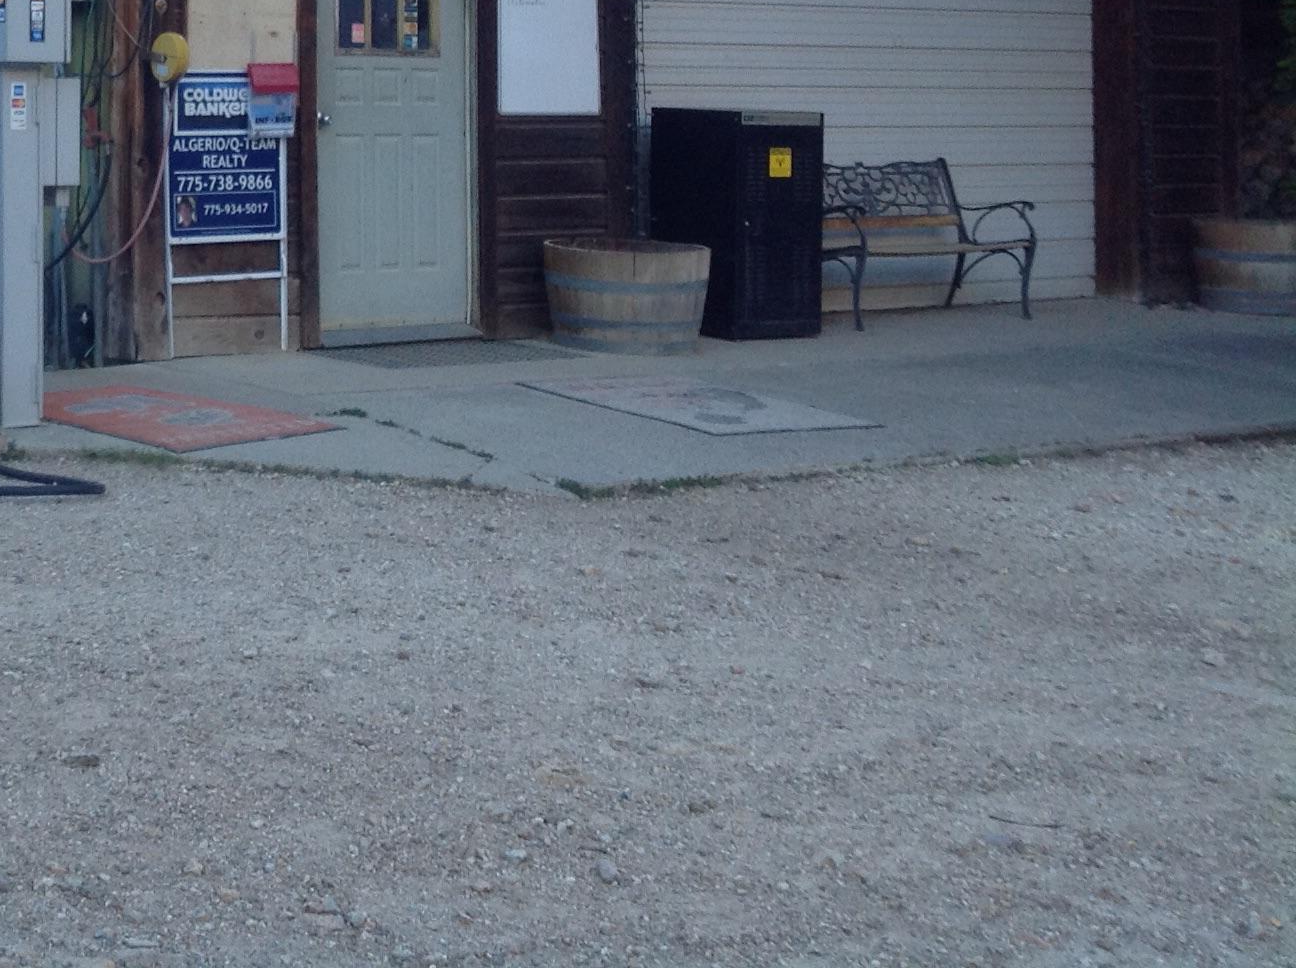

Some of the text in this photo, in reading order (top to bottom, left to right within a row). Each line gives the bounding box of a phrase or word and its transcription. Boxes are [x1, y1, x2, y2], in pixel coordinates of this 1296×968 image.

[172, 137, 277, 153] ALGERIO/Q-TEAM
[202, 154, 248, 168] REALTY
[177, 174, 273, 192] 775-738-9866
[203, 203, 269, 216] 775-934-5017
